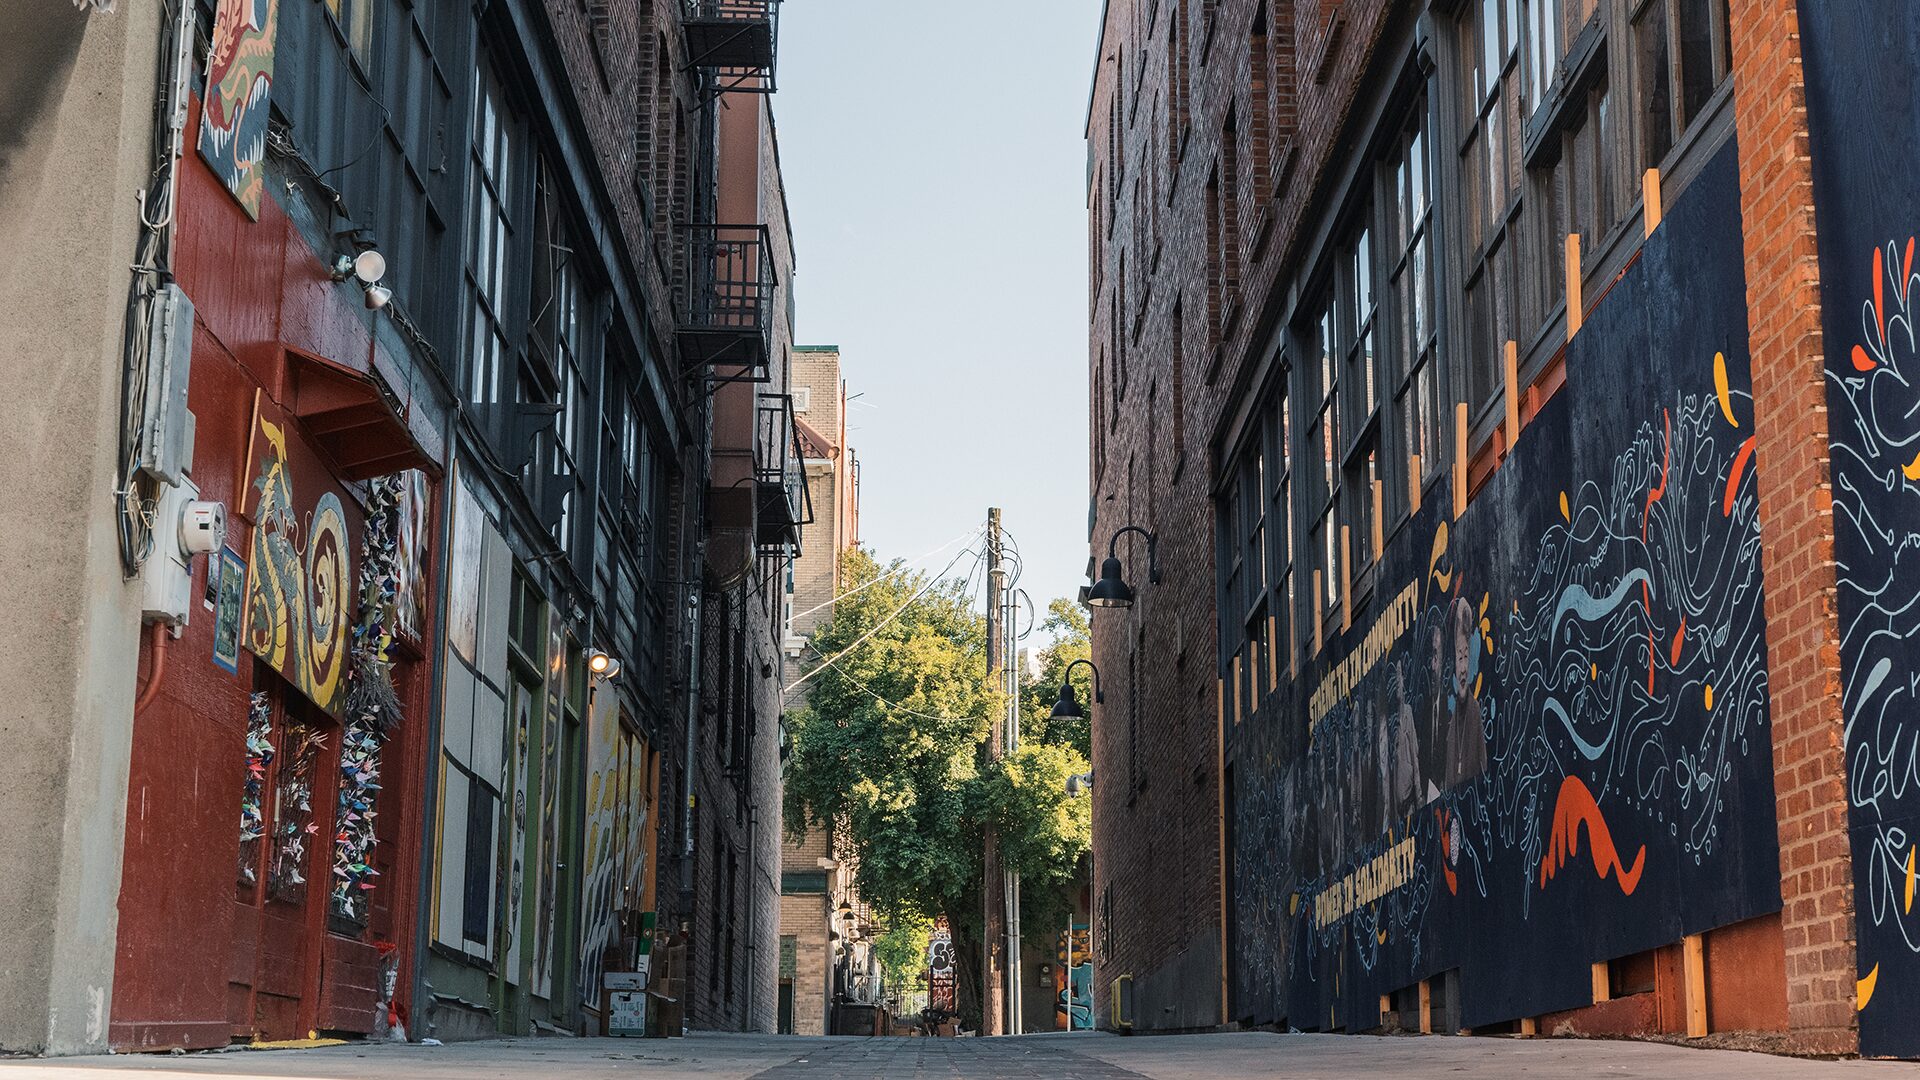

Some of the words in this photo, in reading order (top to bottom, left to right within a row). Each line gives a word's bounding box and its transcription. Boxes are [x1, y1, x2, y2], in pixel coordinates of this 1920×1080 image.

[1309, 656, 1349, 735] STRENGTH
[1350, 643, 1362, 690] IN
[1363, 577, 1419, 677] COMMUNITY
[1315, 881, 1343, 931] POWER
[1343, 873, 1354, 916] IN
[1355, 836, 1416, 909] SOLIDARITY
